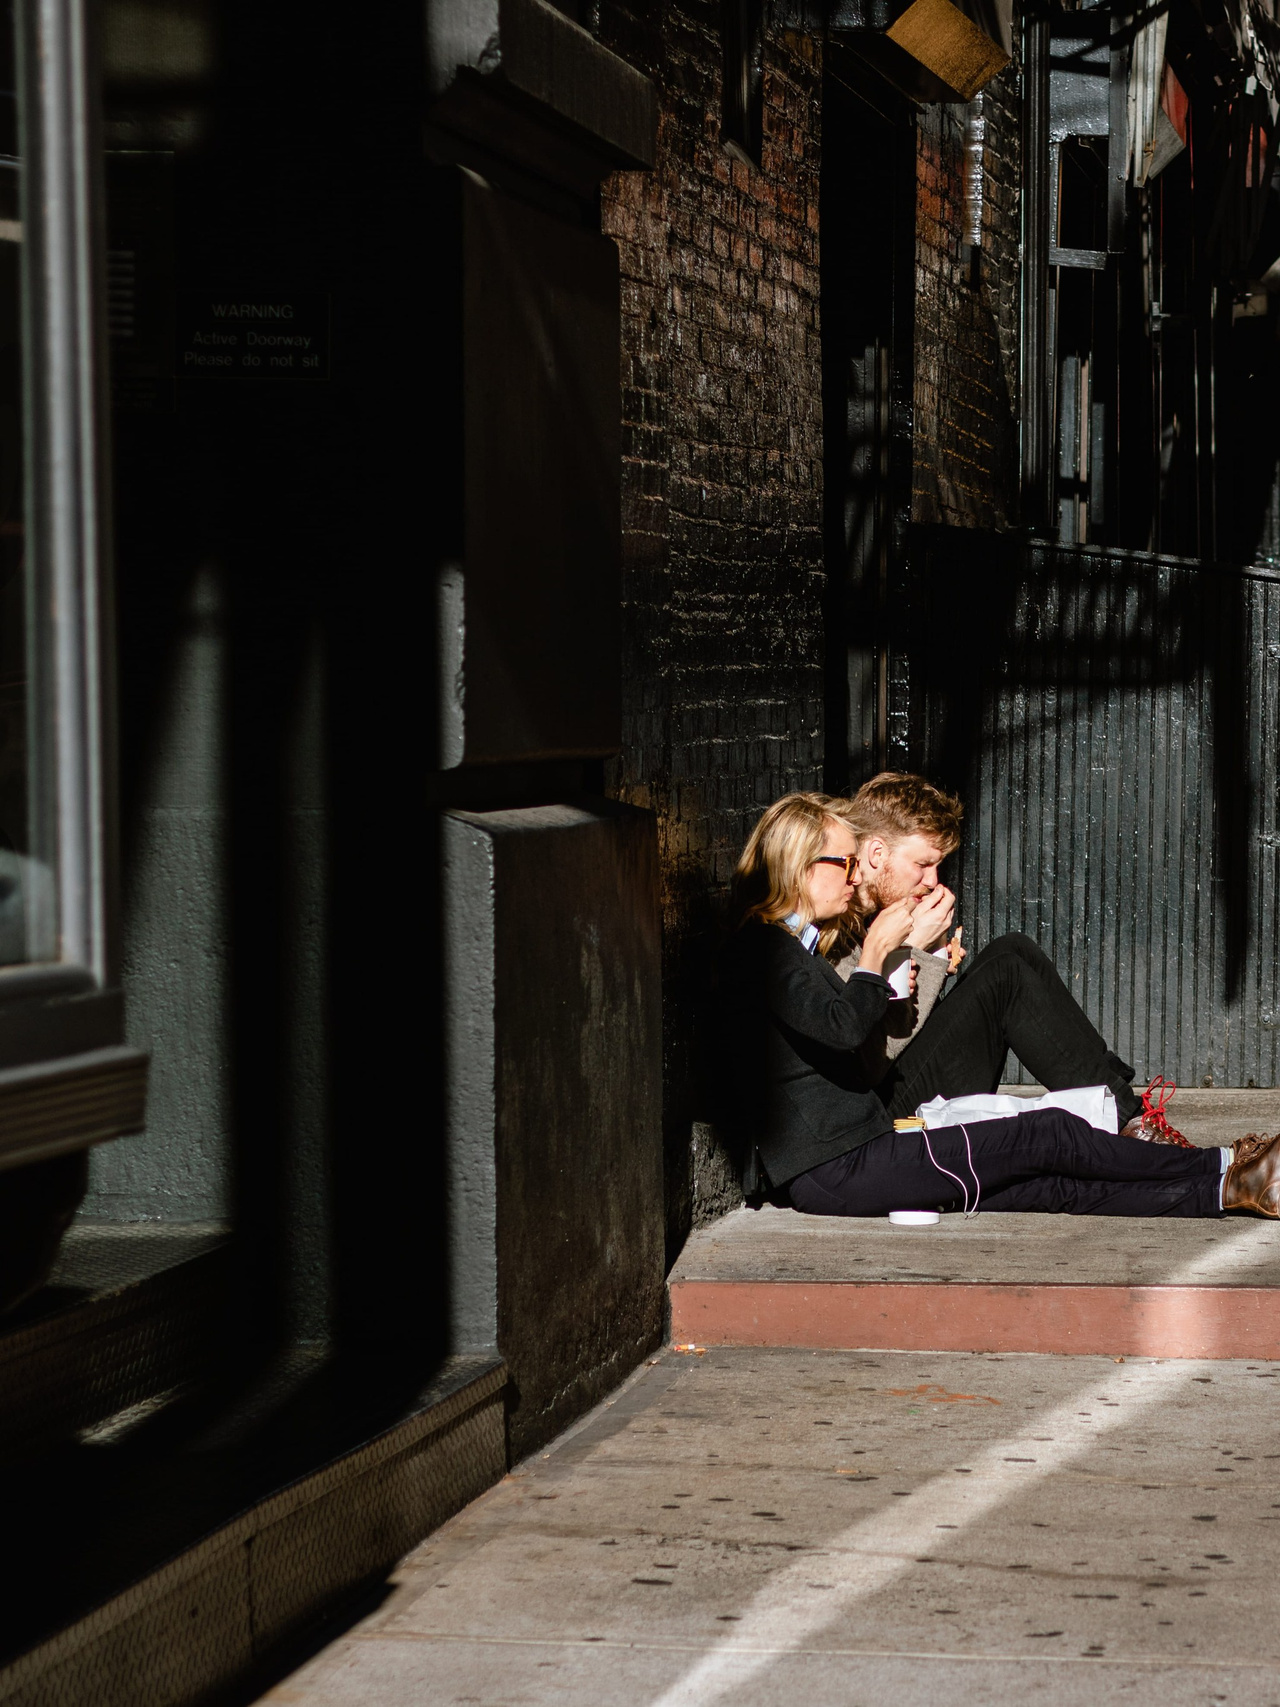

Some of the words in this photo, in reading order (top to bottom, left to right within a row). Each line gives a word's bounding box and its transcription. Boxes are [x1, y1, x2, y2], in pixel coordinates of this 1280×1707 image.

[211, 303, 295, 319] WARNING
[193, 331, 238, 346] Active
[247, 331, 311, 349] Doorway
[184, 351, 233, 366] Please
[242, 353, 261, 366] do
[270, 354, 295, 367] not
[302, 353, 320, 368] sit
